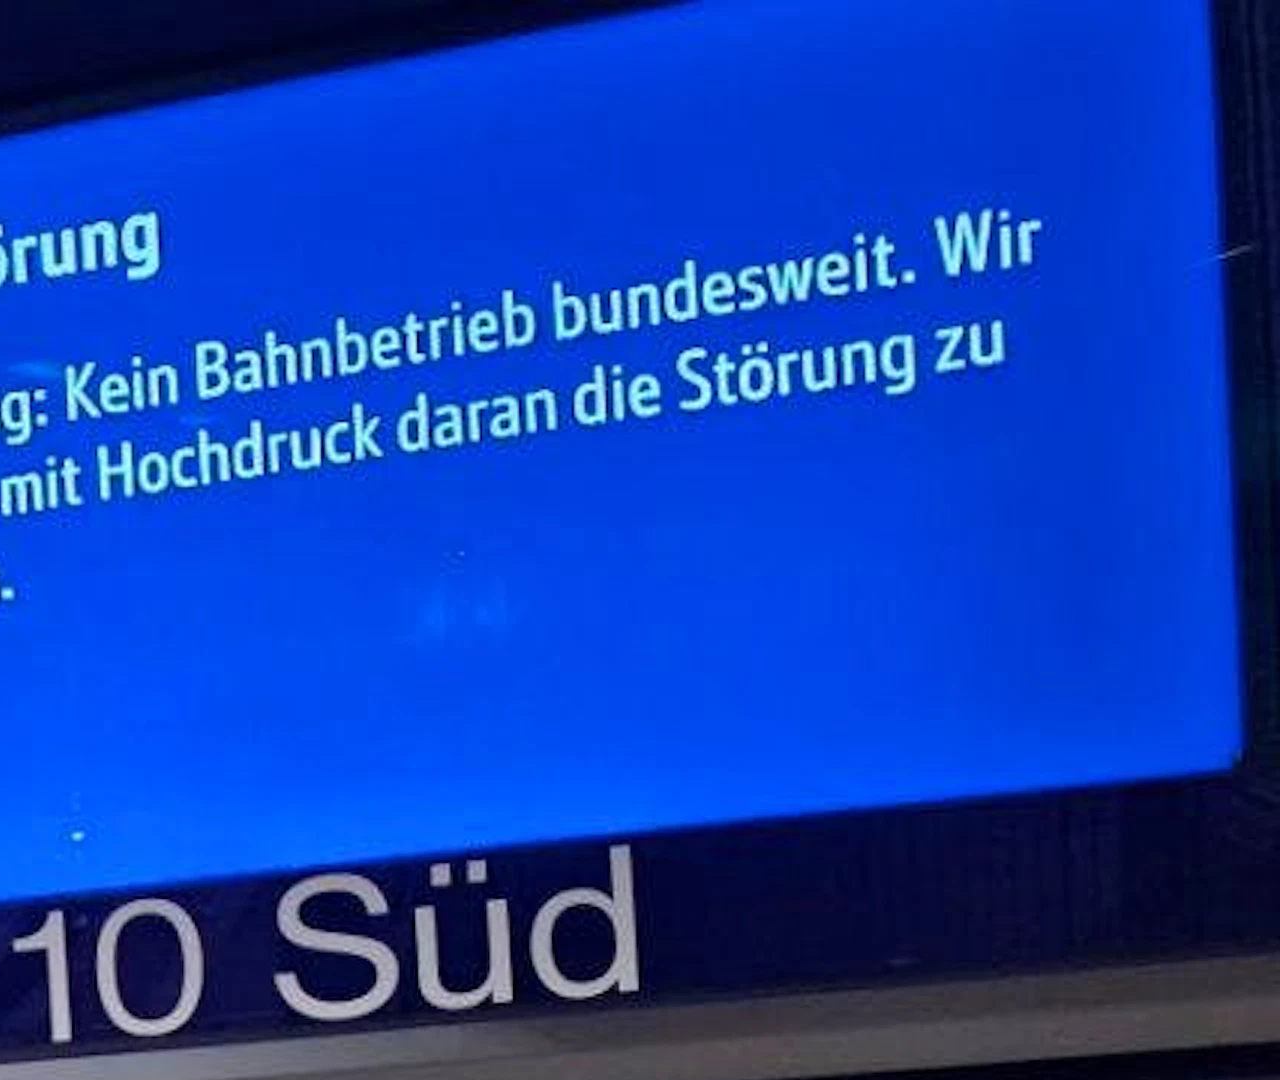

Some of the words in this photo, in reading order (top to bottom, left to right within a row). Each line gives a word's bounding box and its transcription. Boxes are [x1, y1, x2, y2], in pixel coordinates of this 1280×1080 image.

[64, 355, 179, 422] Kein
[194, 290, 536, 401] Bahnbetrieb
[552, 232, 917, 341] bundesweit.
[933, 208, 1043, 277] Wir
[0, 455, 83, 517] mit
[96, 402, 384, 502] Hochdruck
[396, 388, 558, 453] daran
[573, 364, 662, 426] die
[675, 333, 917, 411] Störung
[933, 319, 1005, 373] zu
[12, 898, 204, 1043] 10
[274, 845, 640, 1021] Süd
